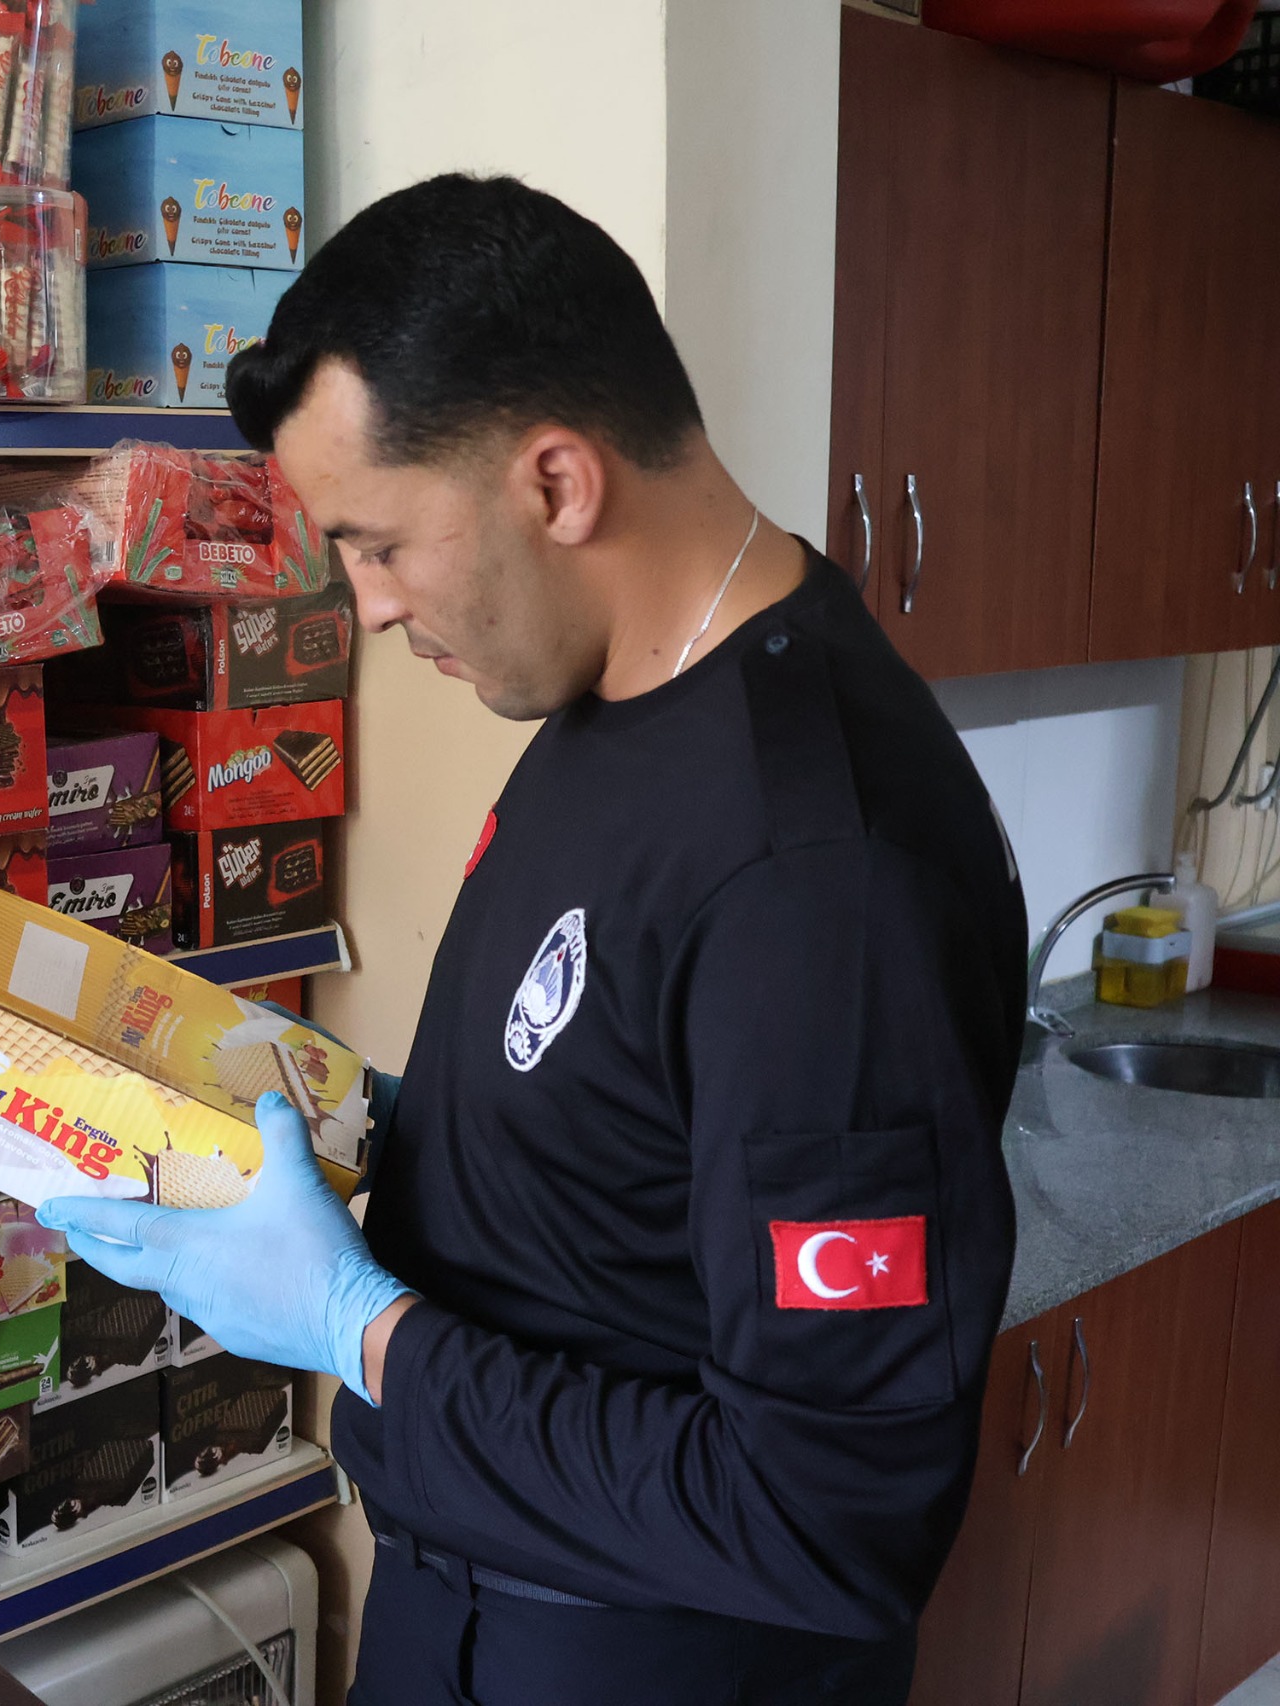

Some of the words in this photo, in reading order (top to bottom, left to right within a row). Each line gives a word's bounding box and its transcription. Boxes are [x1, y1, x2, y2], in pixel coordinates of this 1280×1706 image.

[199, 542, 256, 564] BEBETO
[207, 749, 272, 793] Mongoo
[48, 781, 99, 808] miro
[3, 812, 23, 822] cream
[24, 808, 43, 821] wafer
[51, 890, 117, 915] Emiro
[120, 985, 173, 1034] King
[121, 1027, 145, 1049] My
[1, 1087, 123, 1180] King
[73, 1117, 118, 1148] Ergün
[41, 1377, 51, 1386] 24
